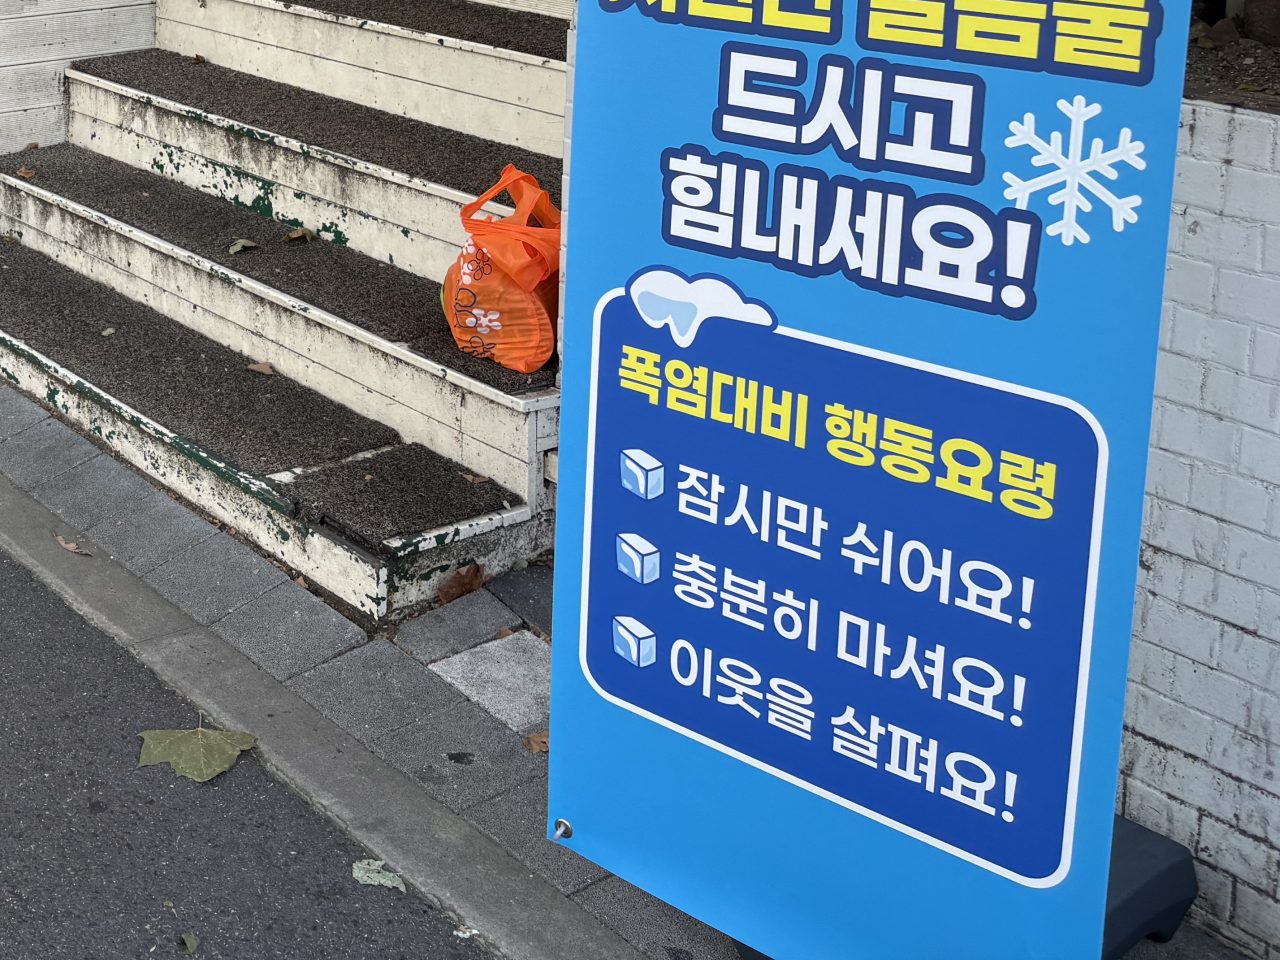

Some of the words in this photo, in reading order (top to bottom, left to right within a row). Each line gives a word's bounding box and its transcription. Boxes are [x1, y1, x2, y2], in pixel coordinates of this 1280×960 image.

[721, 50, 973, 175] 드시고
[667, 154, 1031, 309] 힘내세요!
[618, 344, 808, 448] 폭염대비
[824, 403, 1058, 520] 행동요령
[677, 463, 829, 561] 잠시만
[840, 520, 1035, 630] 쉬어요!
[672, 552, 819, 652] 충분히
[837, 611, 1026, 727] 마셔요!
[669, 638, 815, 742] 이웃을
[831, 705, 1018, 823] 살펴요!
